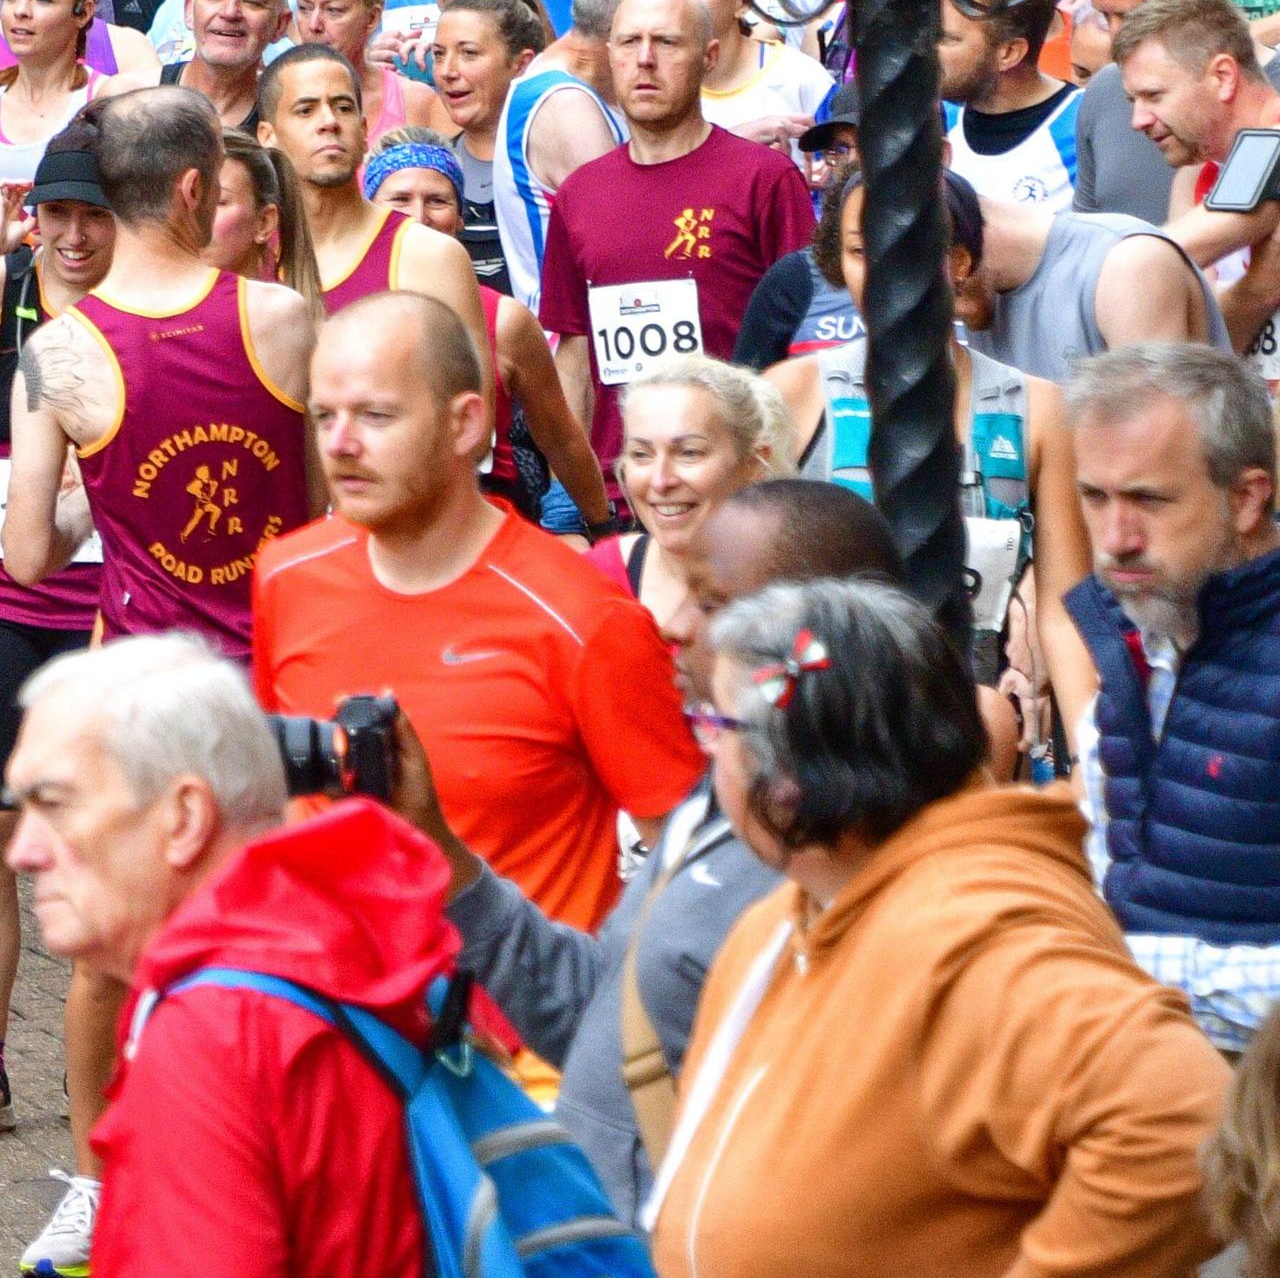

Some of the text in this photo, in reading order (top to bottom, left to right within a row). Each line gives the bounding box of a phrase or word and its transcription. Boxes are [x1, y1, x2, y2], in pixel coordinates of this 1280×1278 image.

[598, 321, 698, 361] 1008
[133, 424, 280, 499] NORTHAMPTON
[222, 459, 238, 480] N
[223, 489, 238, 507] R
[228, 518, 243, 535] R
[148, 542, 203, 584] ROAD
